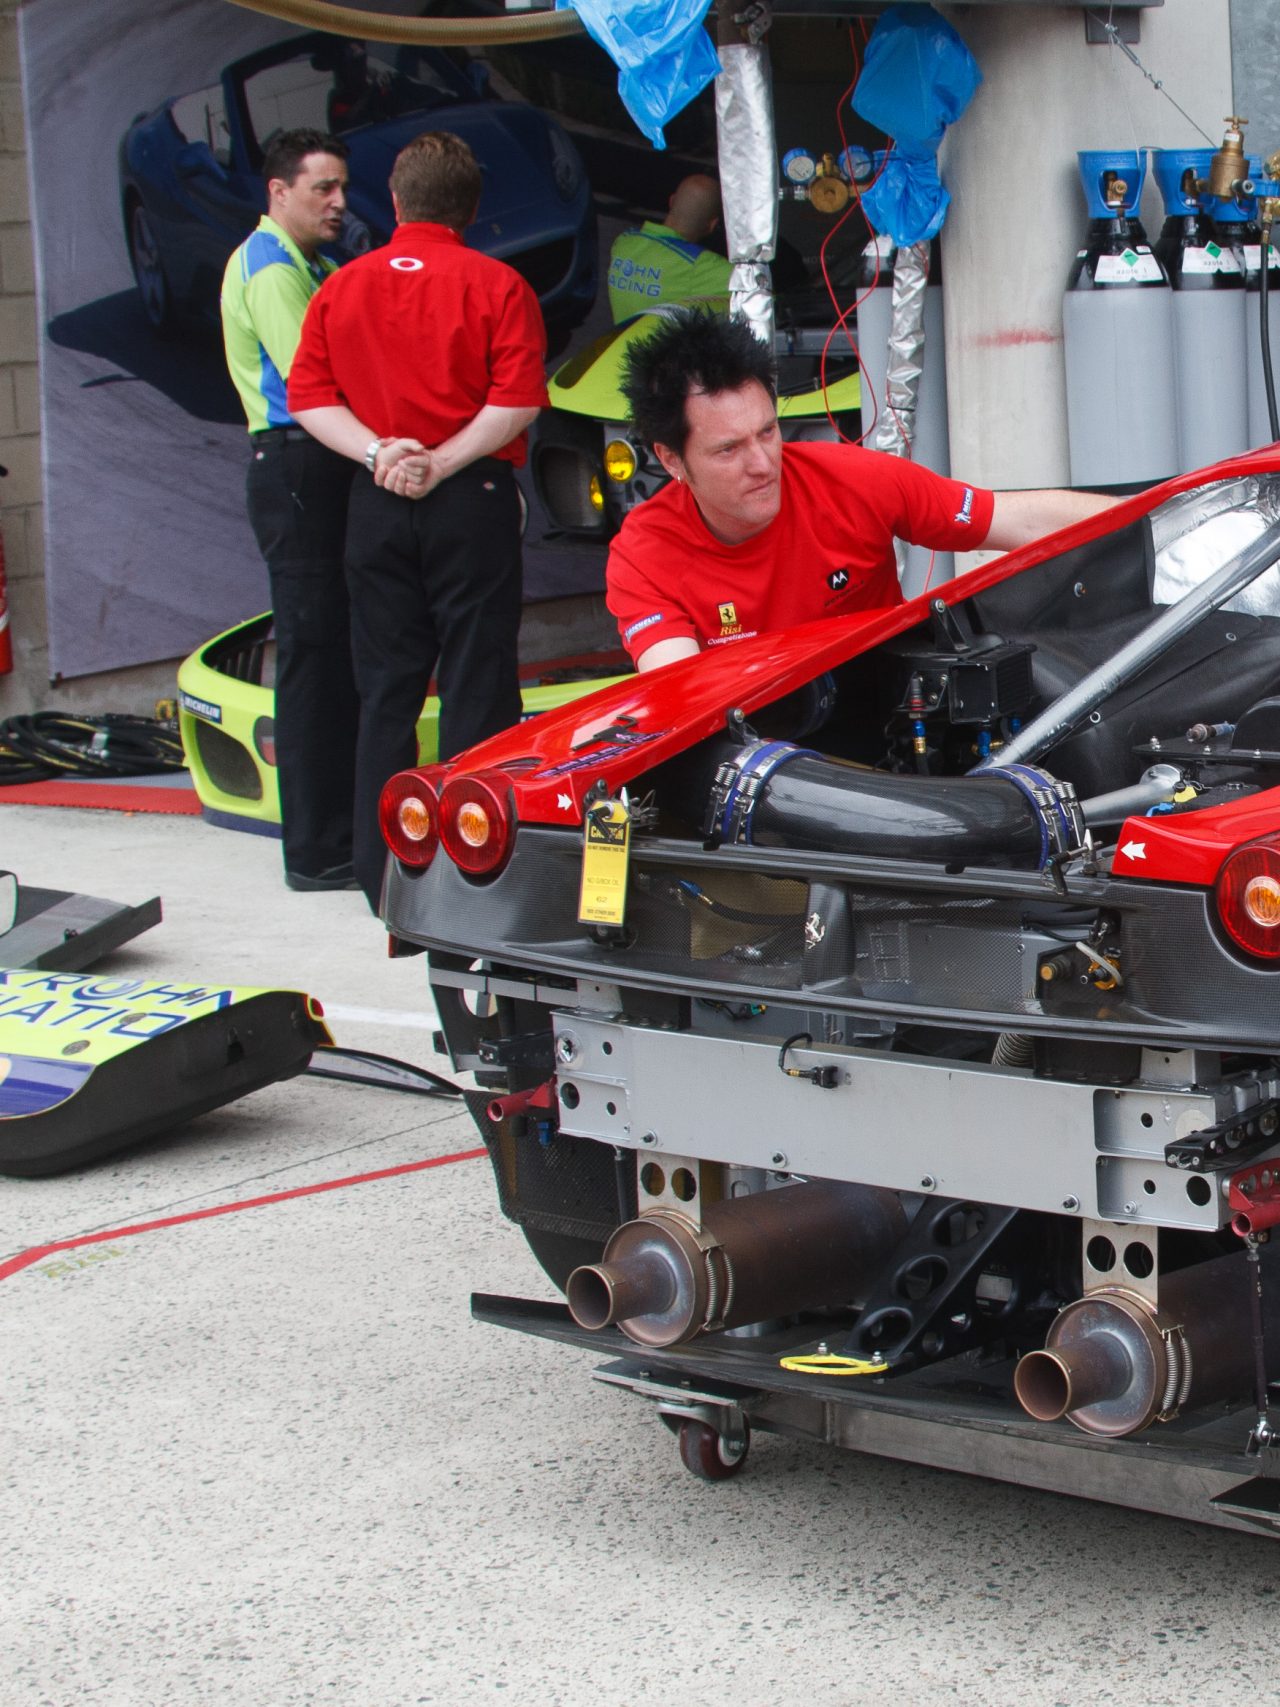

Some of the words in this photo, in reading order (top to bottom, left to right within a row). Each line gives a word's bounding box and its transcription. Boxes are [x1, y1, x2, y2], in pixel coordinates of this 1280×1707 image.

[613, 258, 662, 280] ROHN
[608, 274, 662, 297] ACING
[720, 624, 742, 636] Risi
